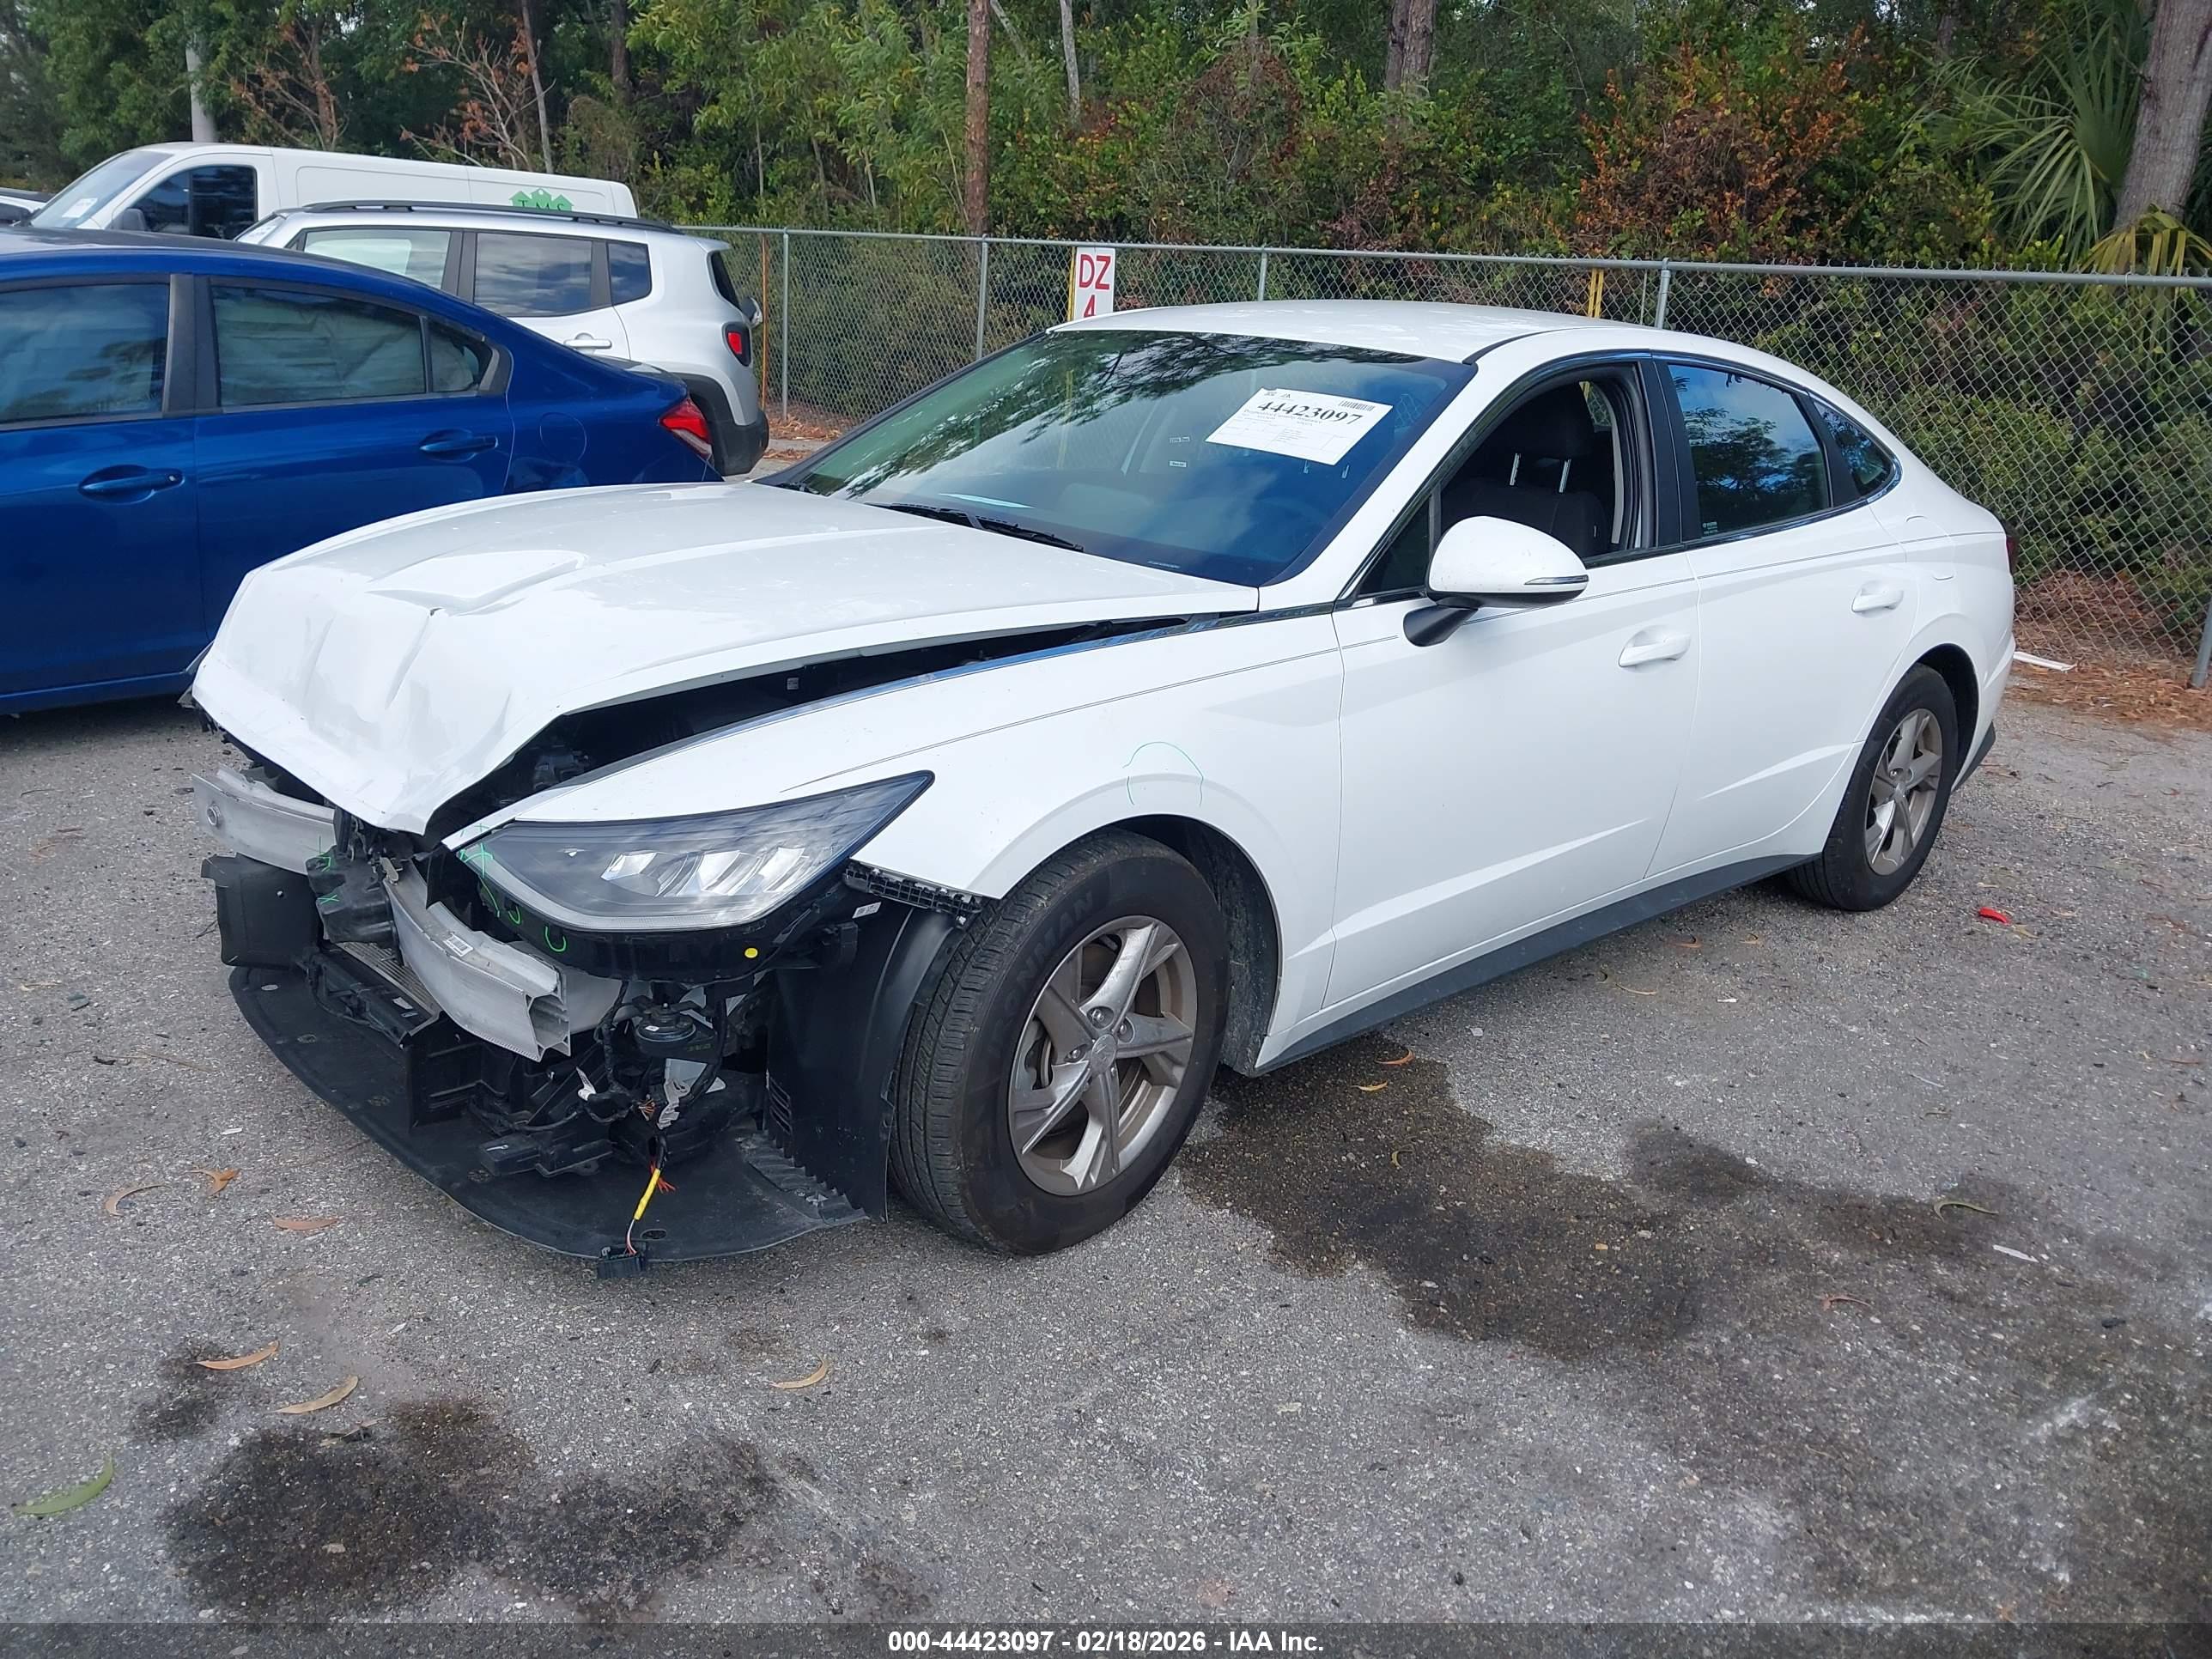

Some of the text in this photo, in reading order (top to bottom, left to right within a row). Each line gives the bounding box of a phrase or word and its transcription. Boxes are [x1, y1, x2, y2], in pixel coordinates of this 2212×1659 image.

[1079, 254, 1111, 289] DZ
[1084, 295, 1096, 318] 4
[1257, 401, 1364, 425] 44423097
